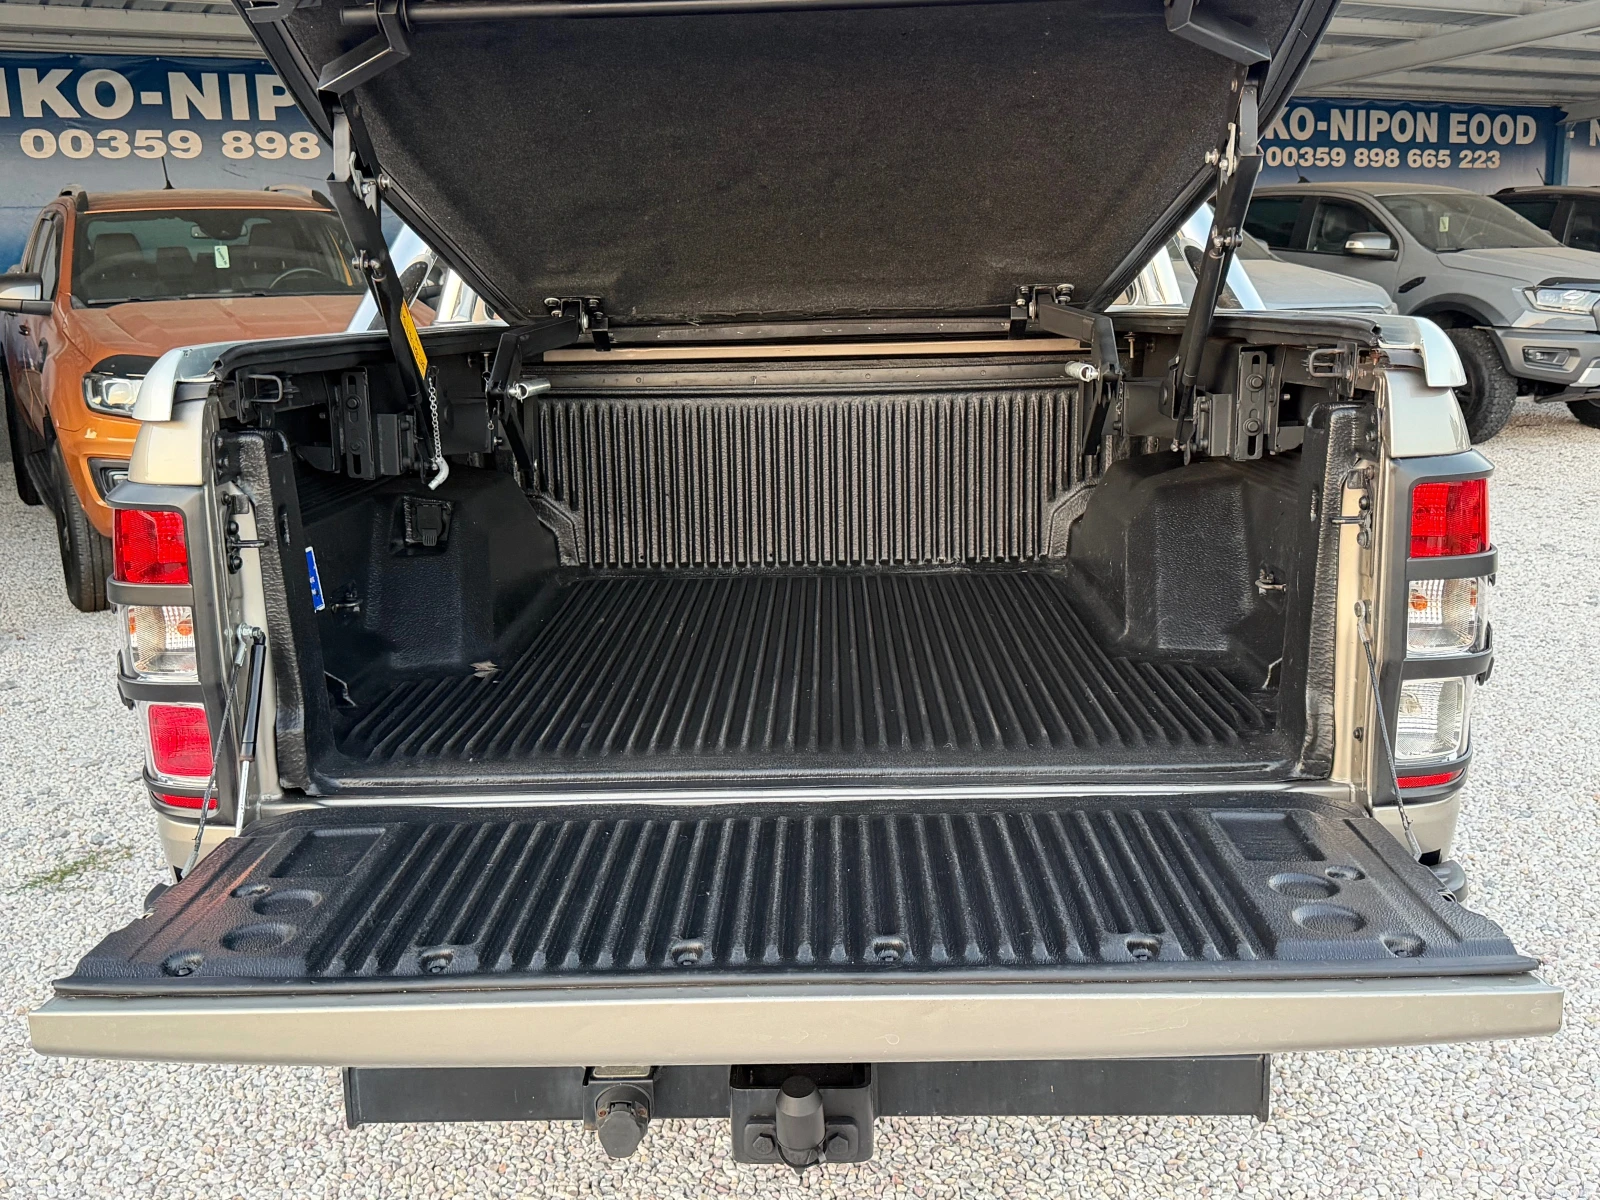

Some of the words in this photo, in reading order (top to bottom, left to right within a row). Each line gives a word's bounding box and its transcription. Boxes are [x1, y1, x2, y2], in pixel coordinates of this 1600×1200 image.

[1265, 107, 1438, 143] KO-NIPON
[1449, 113, 1536, 145] EOOD
[20, 128, 203, 159] 00359
[222, 130, 321, 160] 898
[1265, 146, 1347, 168] 00359
[1353, 147, 1400, 168] 898
[1407, 148, 1451, 169] 665
[1458, 149, 1501, 169] 223
